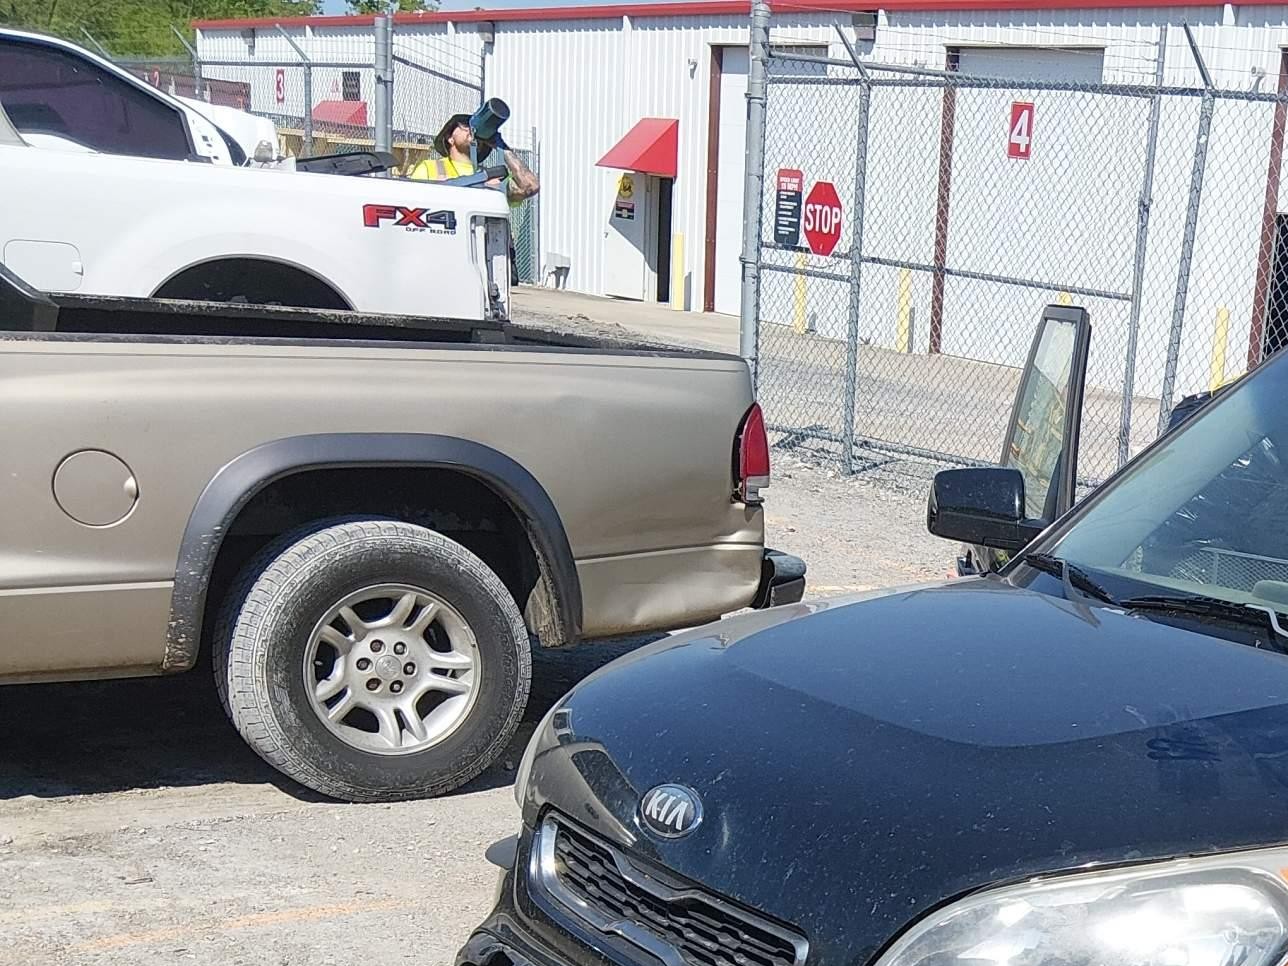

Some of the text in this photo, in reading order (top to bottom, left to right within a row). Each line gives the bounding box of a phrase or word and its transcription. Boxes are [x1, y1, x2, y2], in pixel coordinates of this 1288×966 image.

[277, 73, 284, 100] 3
[1010, 109, 1030, 153] 4
[362, 203, 457, 230] FX4
[805, 203, 841, 235] STOP
[645, 790, 689, 831] KIA
